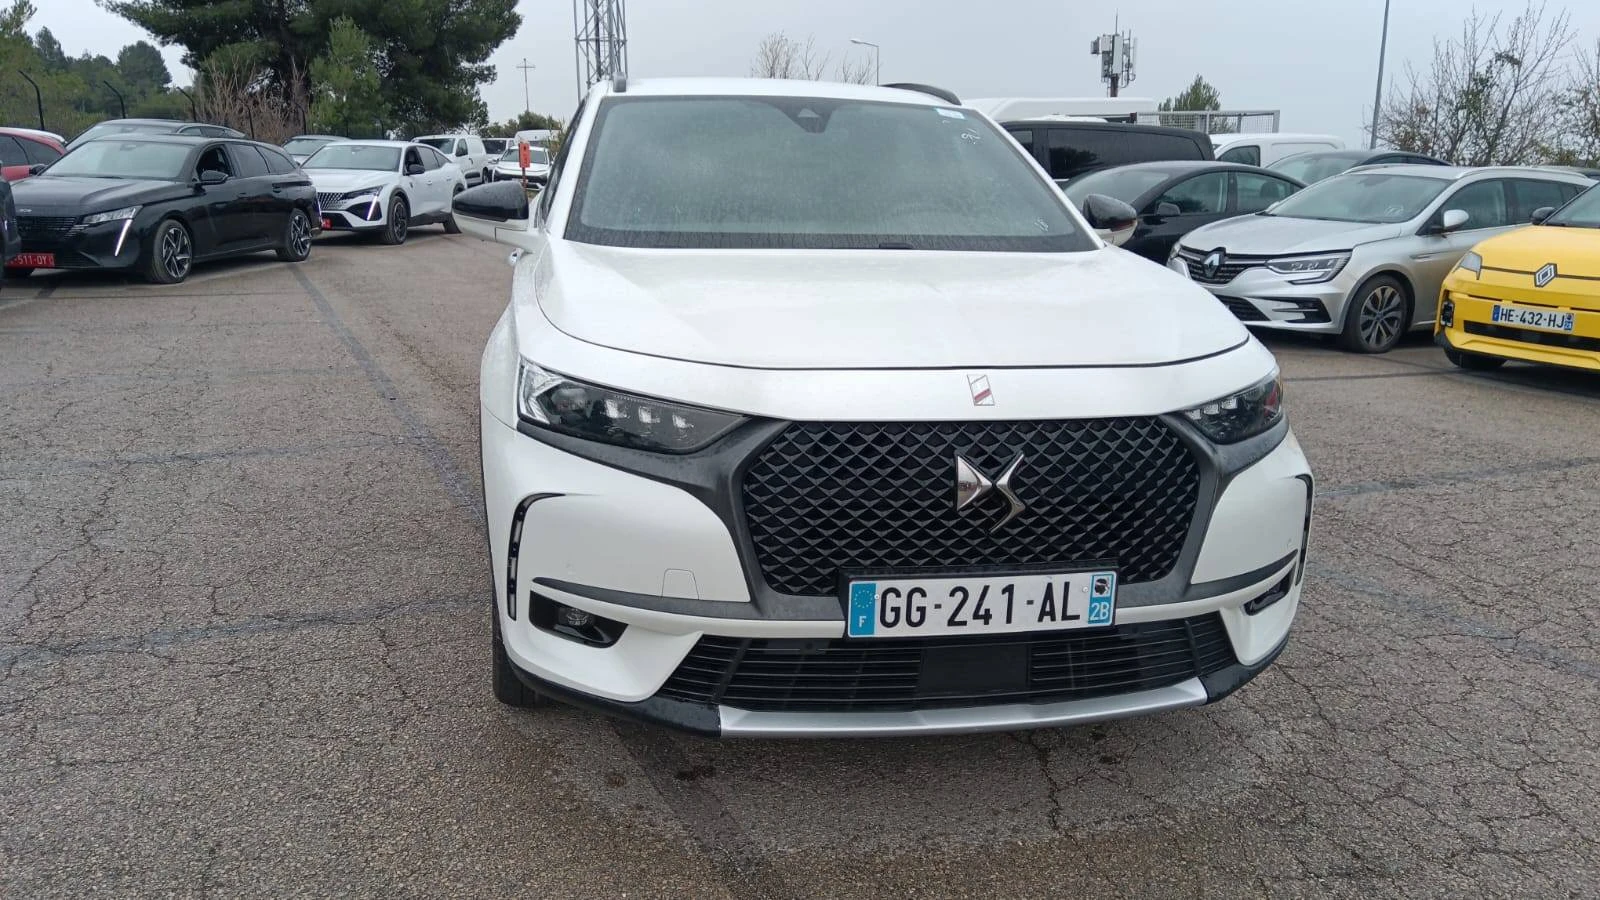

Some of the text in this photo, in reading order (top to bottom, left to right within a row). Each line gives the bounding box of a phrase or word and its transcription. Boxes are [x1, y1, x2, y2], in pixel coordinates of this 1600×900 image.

[1500, 307, 1565, 328] HE-432-HJ
[879, 581, 1081, 628] GG-241-AL
[1089, 601, 1110, 621] 2B
[858, 615, 867, 628] F
